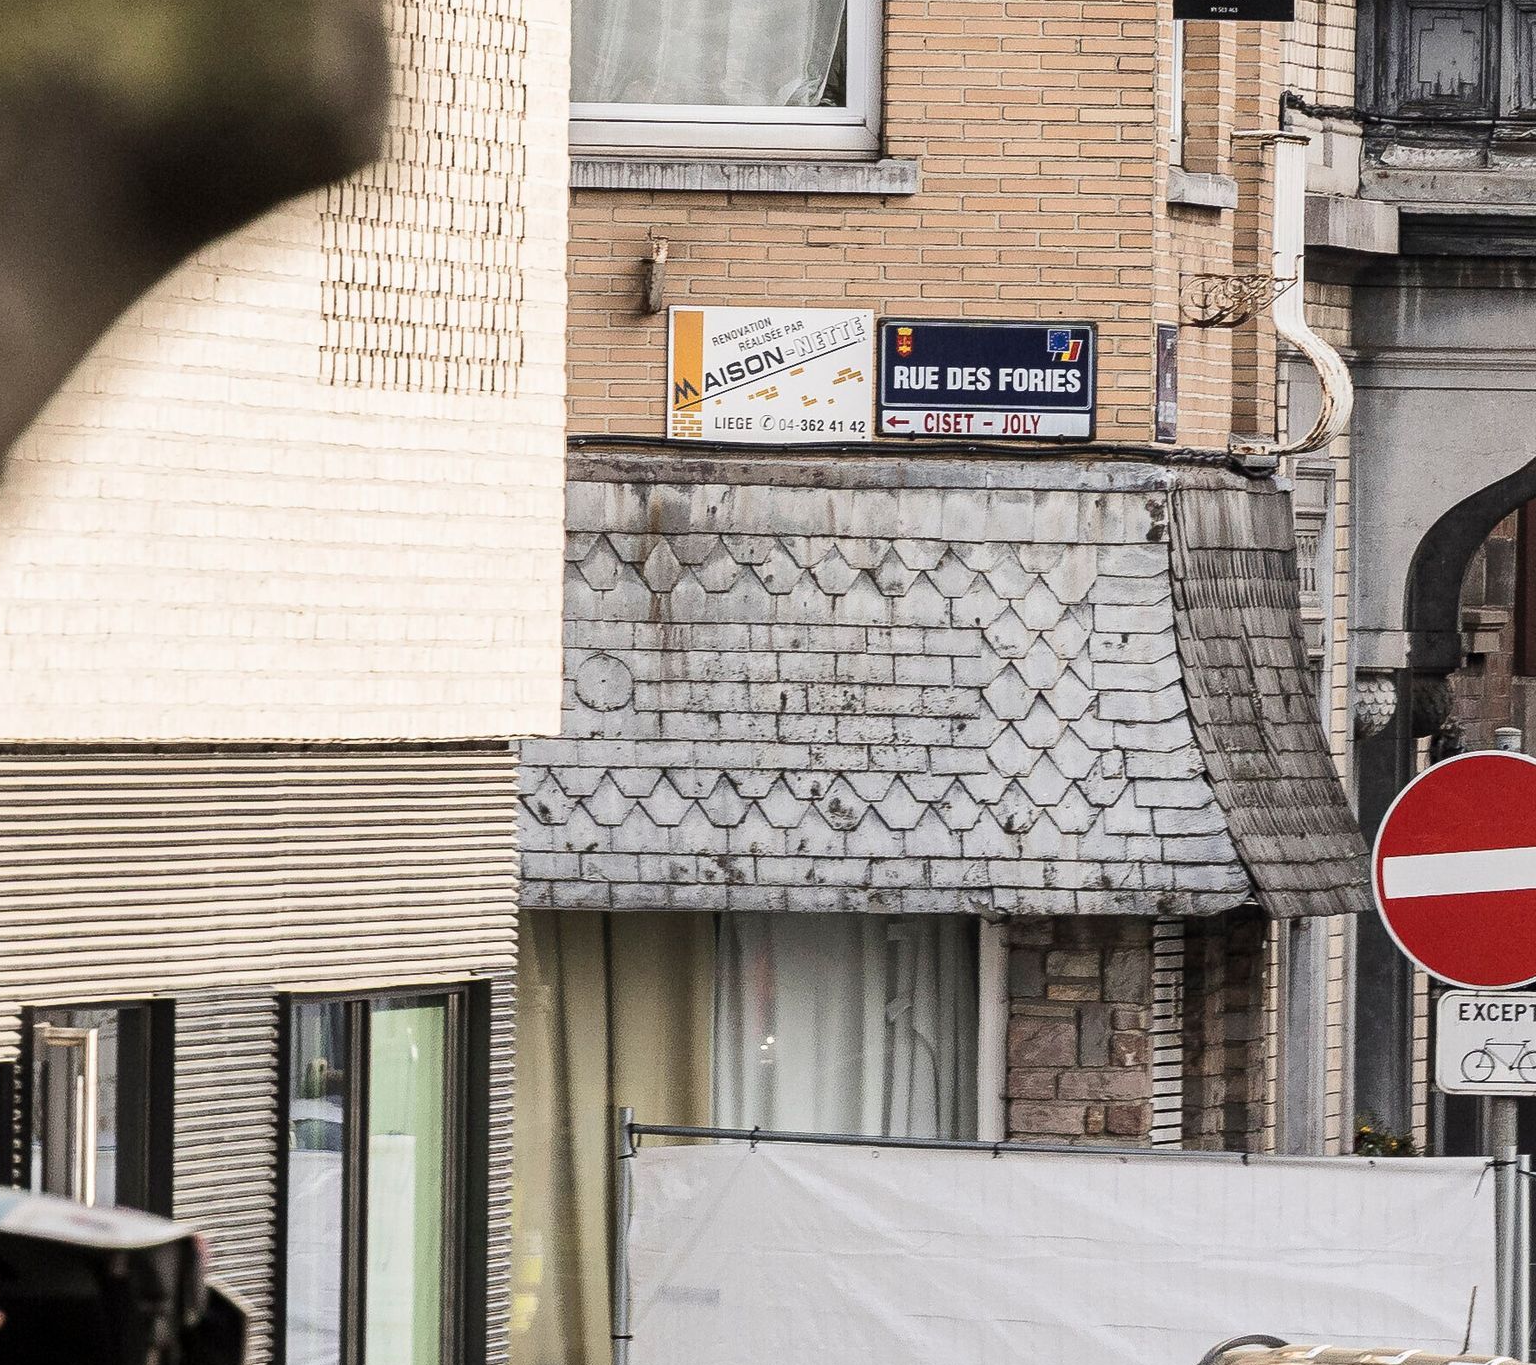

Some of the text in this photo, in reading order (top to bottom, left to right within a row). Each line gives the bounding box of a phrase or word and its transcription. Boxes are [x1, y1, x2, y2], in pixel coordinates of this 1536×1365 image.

[712, 317, 772, 346] RENOVATION
[739, 320, 805, 352] RÉALISÉE PAR
[894, 365, 1081, 393] RUE DES FORIES
[714, 417, 753, 430] LIEGE
[829, 420, 844, 432] 41
[850, 421, 865, 433] 42
[924, 412, 974, 433] CISET
[1002, 414, 1041, 434] JOLY
